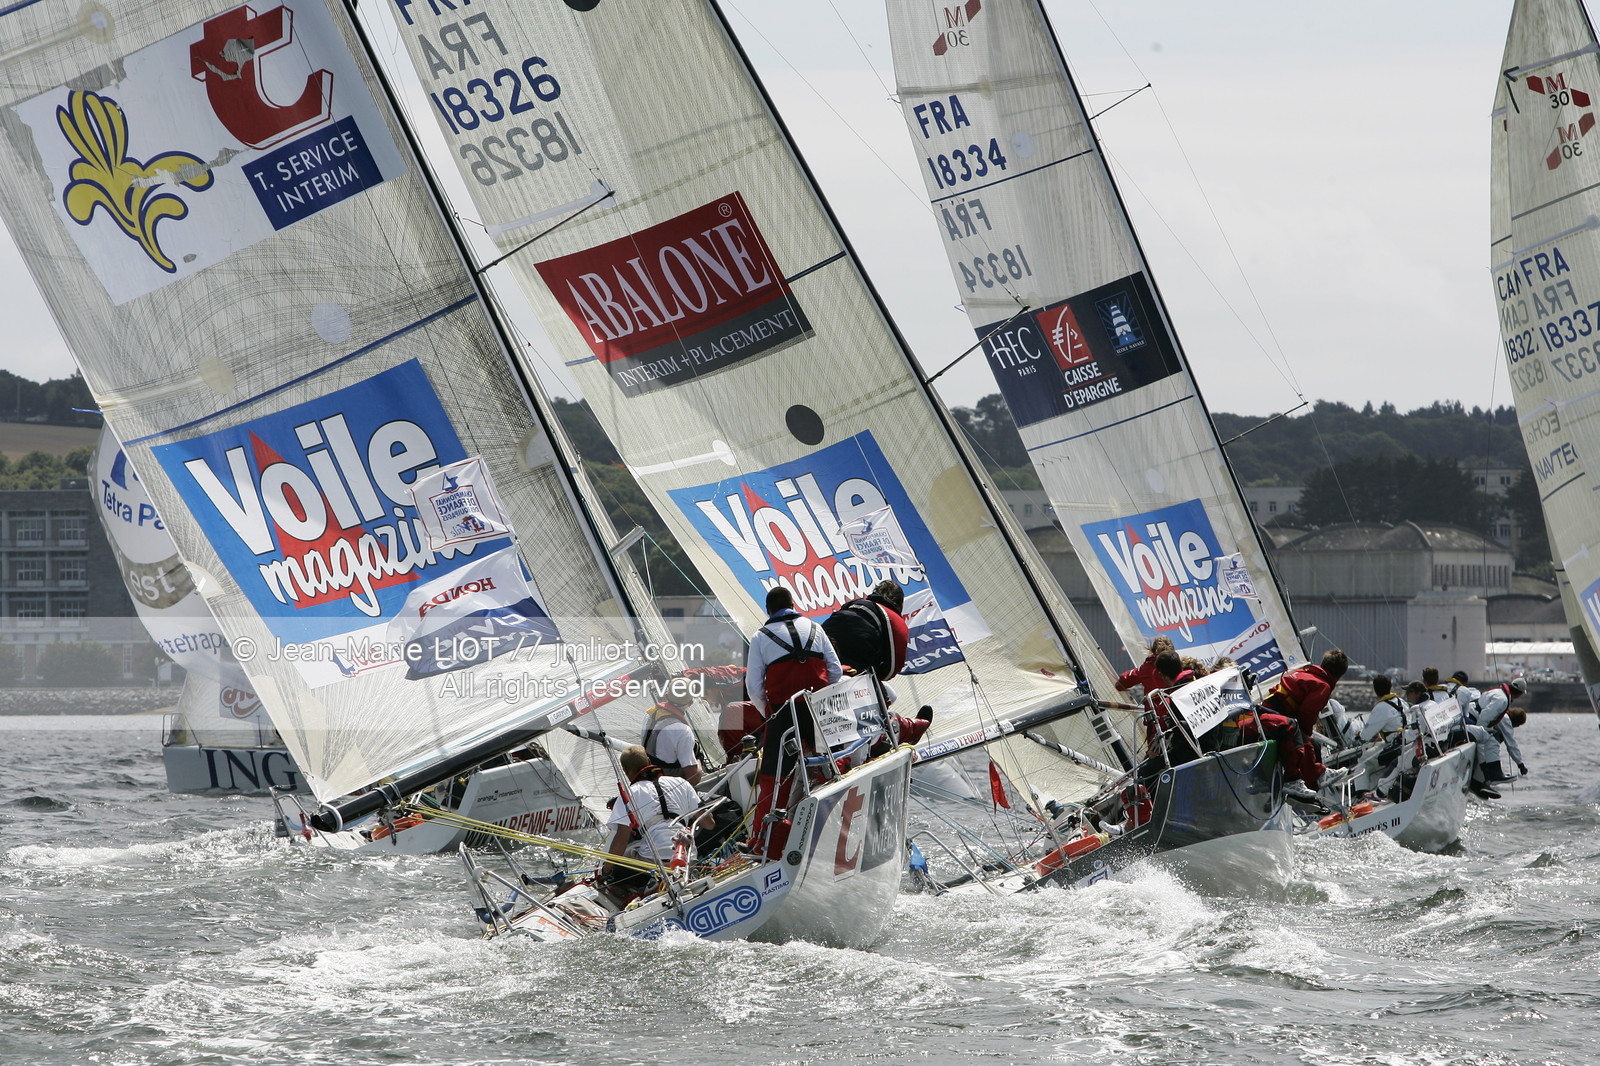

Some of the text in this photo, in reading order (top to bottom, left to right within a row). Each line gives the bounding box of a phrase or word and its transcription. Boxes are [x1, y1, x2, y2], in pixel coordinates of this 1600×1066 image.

[431, 56, 561, 135] 18326
[913, 95, 971, 139] FRA
[1550, 91, 1570, 109] 30
[278, 131, 358, 182] SERVICE
[927, 137, 1007, 190] 18334
[276, 161, 359, 213] INTERIM
[565, 218, 772, 343] ABALONE
[1520, 247, 1571, 287] FRA
[617, 356, 682, 388] INTÉRIM
[691, 309, 796, 366] PLACEMENT
[988, 327, 1041, 370] HEC
[1505, 327, 1540, 365] 1832
[1017, 365, 1037, 377] PARIS
[1063, 376, 1122, 409] D'EPARGNE
[1064, 361, 1102, 386] CAISSE
[101, 480, 133, 524] Tetra
[184, 412, 441, 557] Voile
[695, 472, 888, 573] Voile
[1097, 520, 1213, 593] Voile
[130, 567, 176, 601] est
[1136, 578, 1234, 643] magazine
[200, 749, 298, 791] ING
[689, 888, 758, 933] arc
[761, 881, 790, 898] PLASTIMO
